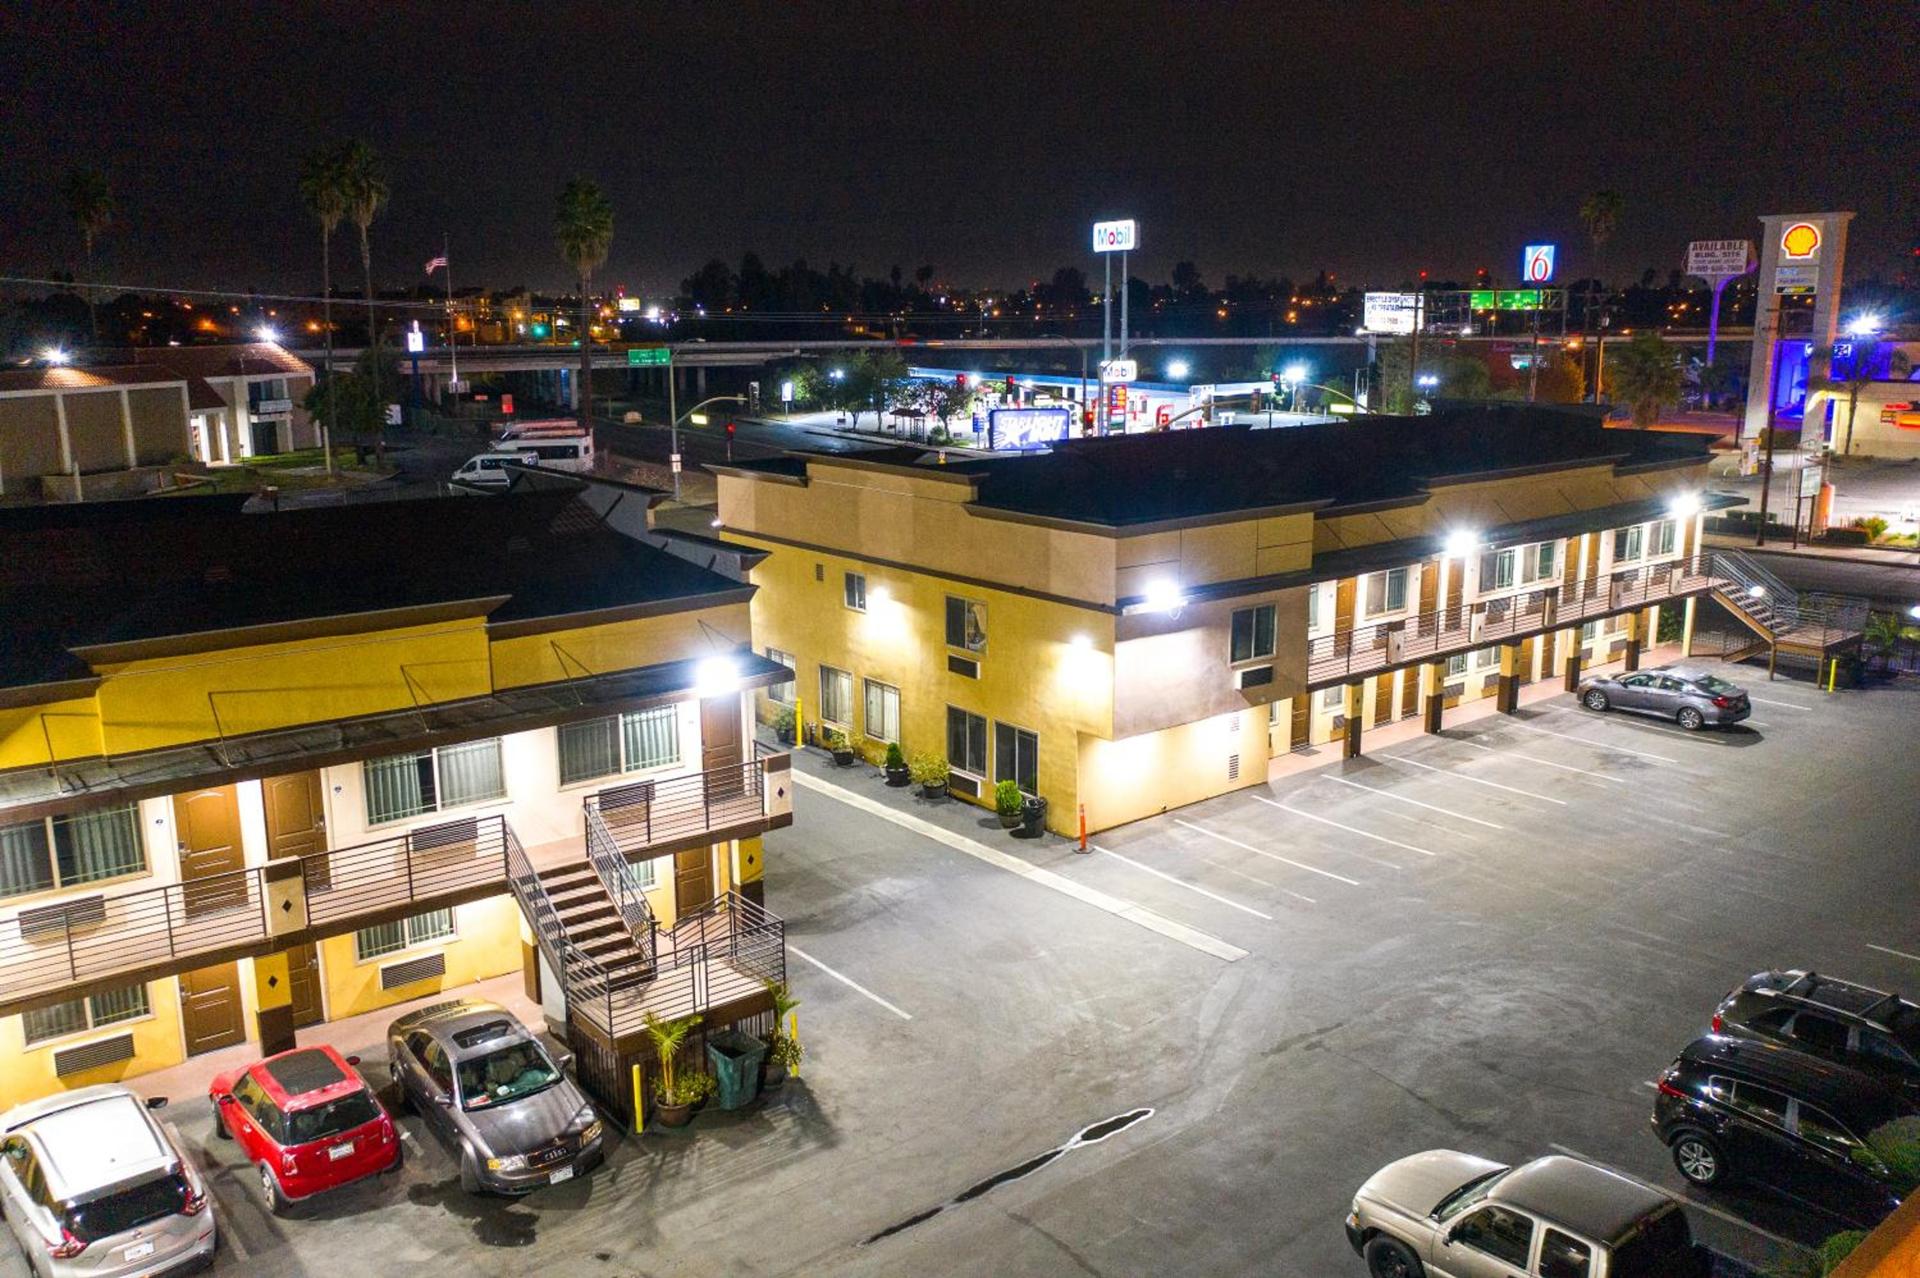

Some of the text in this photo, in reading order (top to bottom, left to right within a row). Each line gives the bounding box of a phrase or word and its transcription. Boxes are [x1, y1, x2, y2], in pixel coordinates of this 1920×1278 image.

[1098, 225, 1131, 246] Mobil
[1692, 240, 1745, 251] AVAILABLE
[1531, 248, 1549, 282] 6
